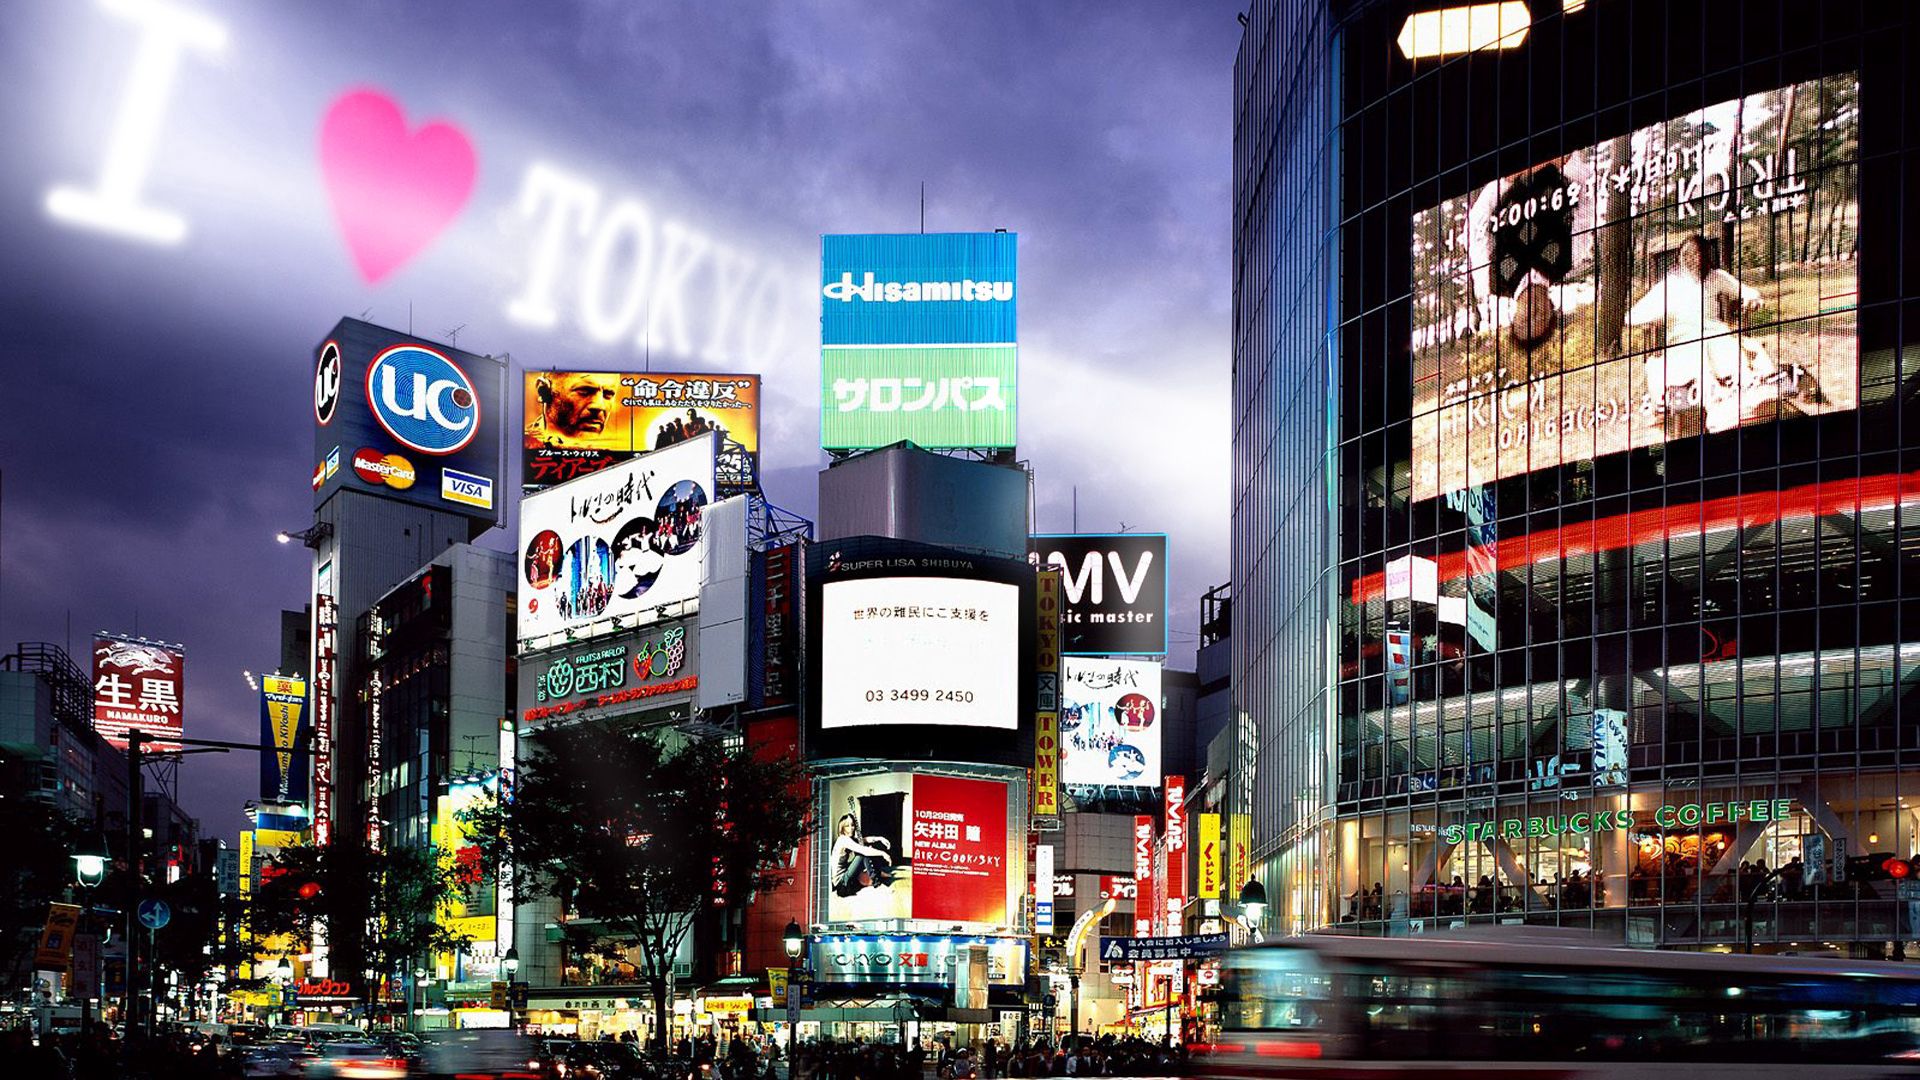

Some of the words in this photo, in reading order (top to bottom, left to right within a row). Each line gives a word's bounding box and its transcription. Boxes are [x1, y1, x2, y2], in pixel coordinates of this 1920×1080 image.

[823, 271, 1013, 302] Hisamitsu
[832, 376, 1006, 412] サロンパス
[354, 457, 416, 481] MasterCard
[451, 480, 483, 498] VISA
[841, 559, 883, 572] SUPER
[887, 559, 916, 567] LISA
[921, 559, 974, 570] SHIBUYA
[1029, 550, 1154, 605] MV
[1039, 578, 1056, 668] TOKYO
[1090, 611, 1154, 623] master
[575, 658, 625, 693] 西村
[94, 673, 179, 715] 生黒
[866, 690, 884, 702] 03
[890, 689, 929, 701] 3499
[935, 690, 974, 703] 2450
[1038, 676, 1055, 710] 文庫
[106, 710, 169, 724] NAMAKURO
[279, 740, 289, 794] Matsumoo
[1037, 717, 1055, 806] TOWER
[914, 820, 959, 841] 矢井田
[1167, 786, 1184, 852] さくらや
[1446, 809, 1635, 845] STARBUCKS
[1655, 799, 1792, 829] COFFEE
[898, 952, 929, 968] 文庫
[935, 953, 1007, 970] TOER
